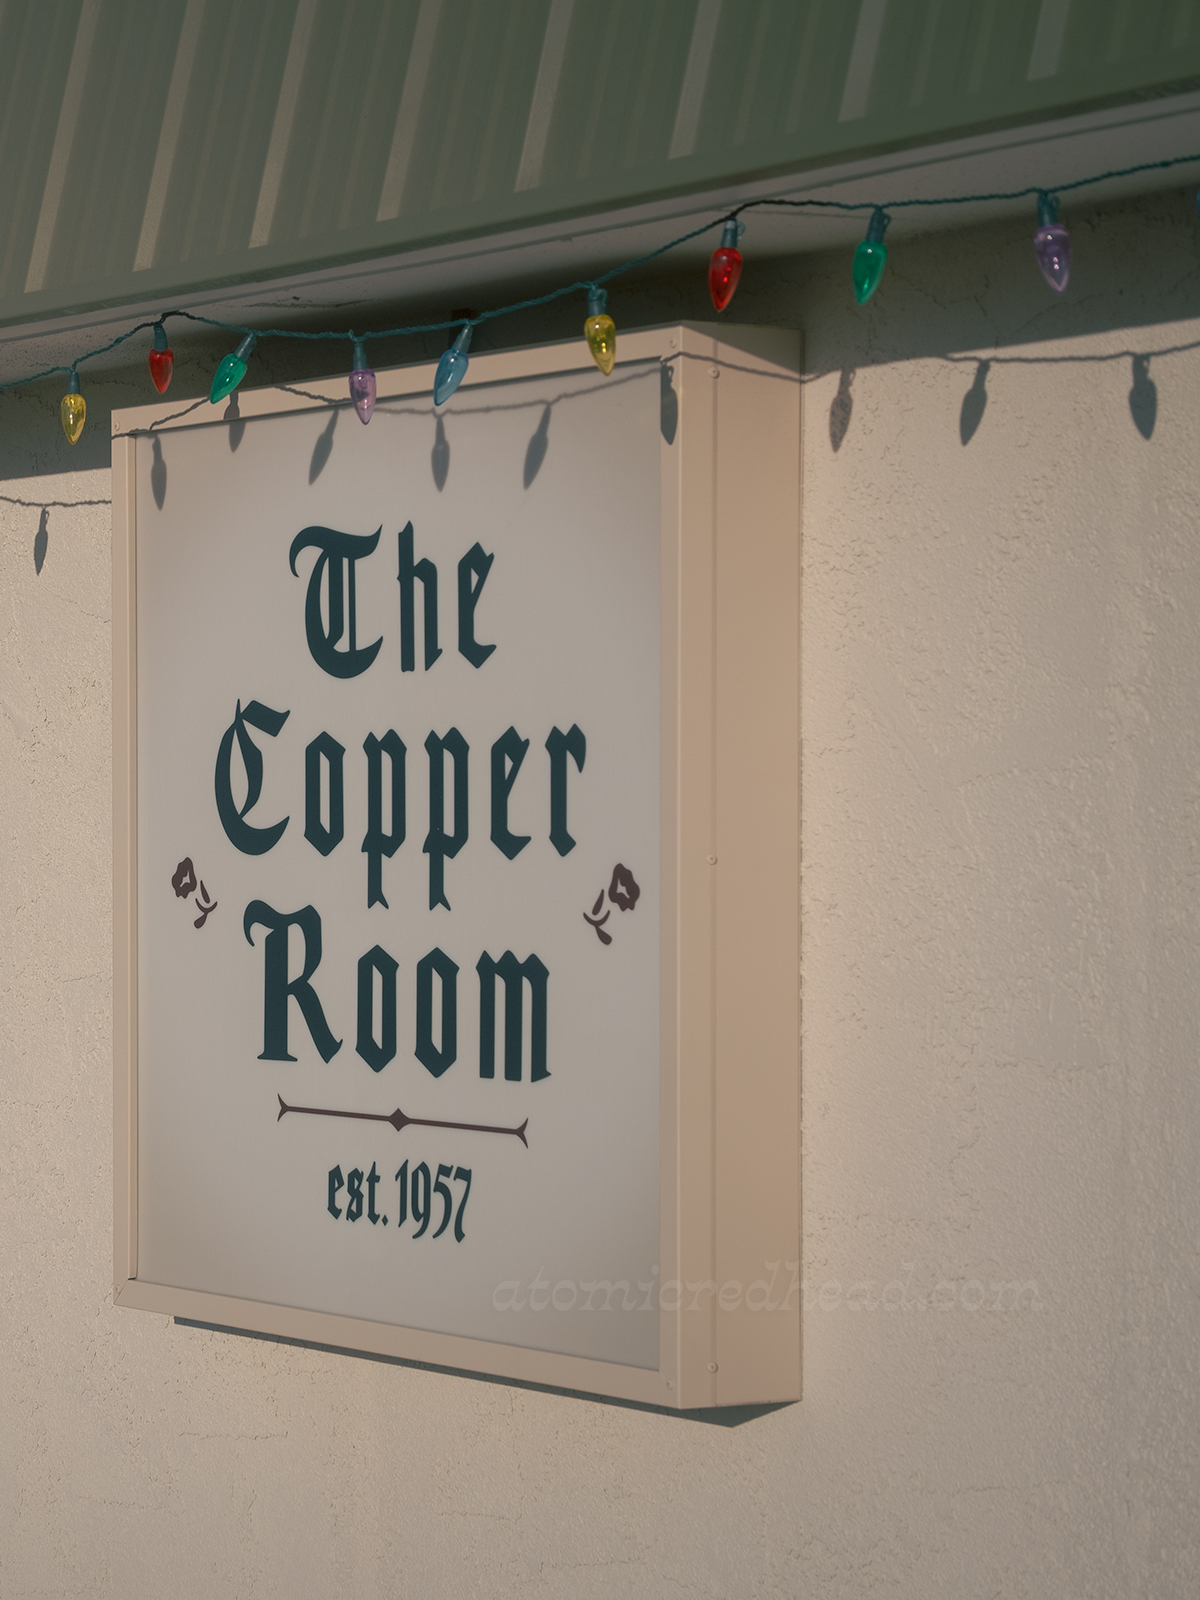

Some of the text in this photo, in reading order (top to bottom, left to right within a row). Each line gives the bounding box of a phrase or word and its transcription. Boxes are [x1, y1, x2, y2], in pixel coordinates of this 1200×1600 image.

[288, 520, 497, 680] The
[214, 698, 587, 913] Copper
[243, 899, 552, 1083] Room
